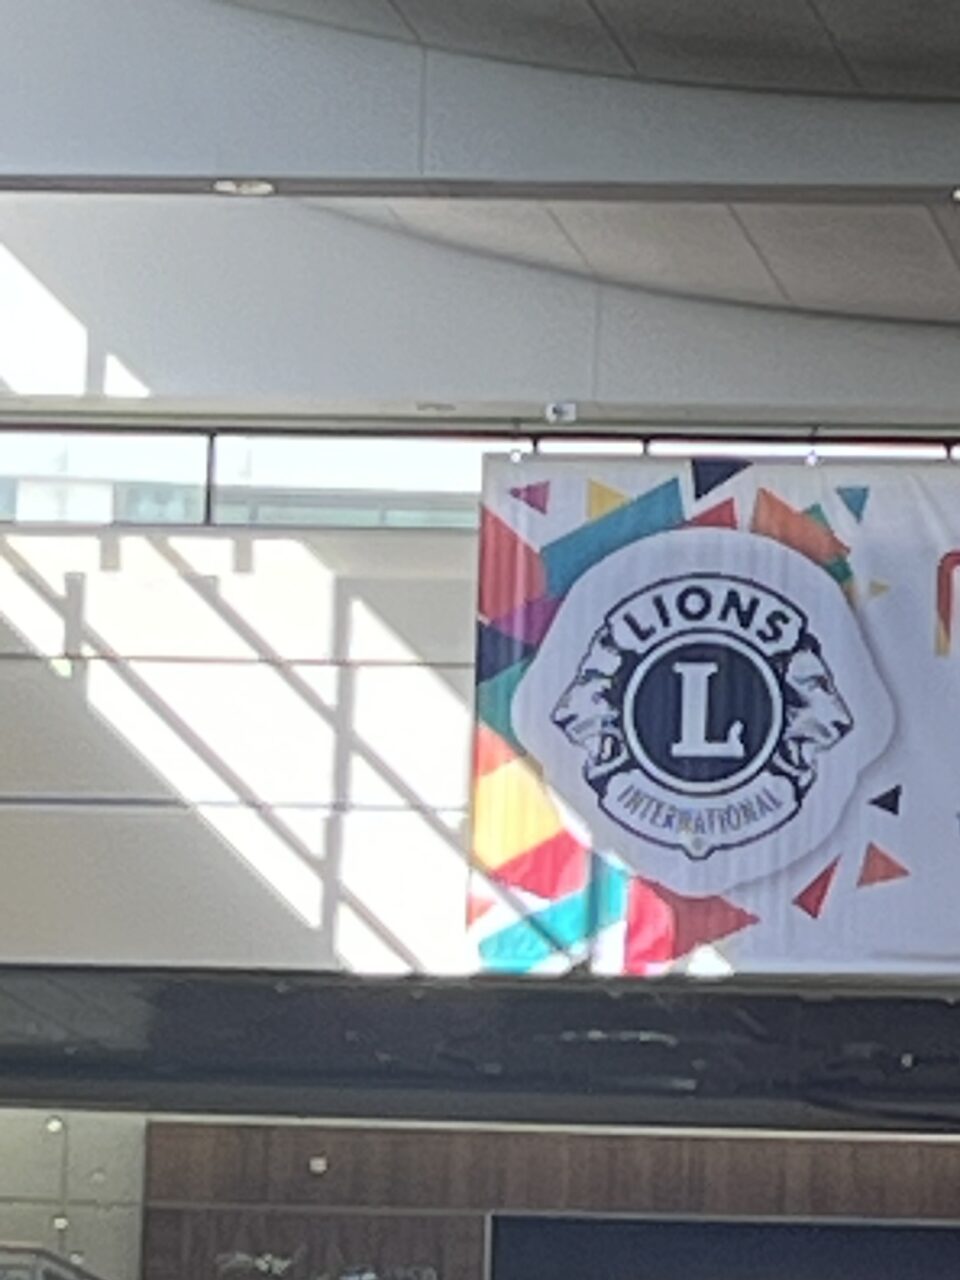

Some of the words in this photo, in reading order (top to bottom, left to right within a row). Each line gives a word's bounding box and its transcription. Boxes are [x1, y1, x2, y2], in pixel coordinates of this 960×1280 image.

[622, 584, 792, 644] LIONS
[671, 661, 745, 758] L
[617, 784, 784, 836] INTERNATIONAL
